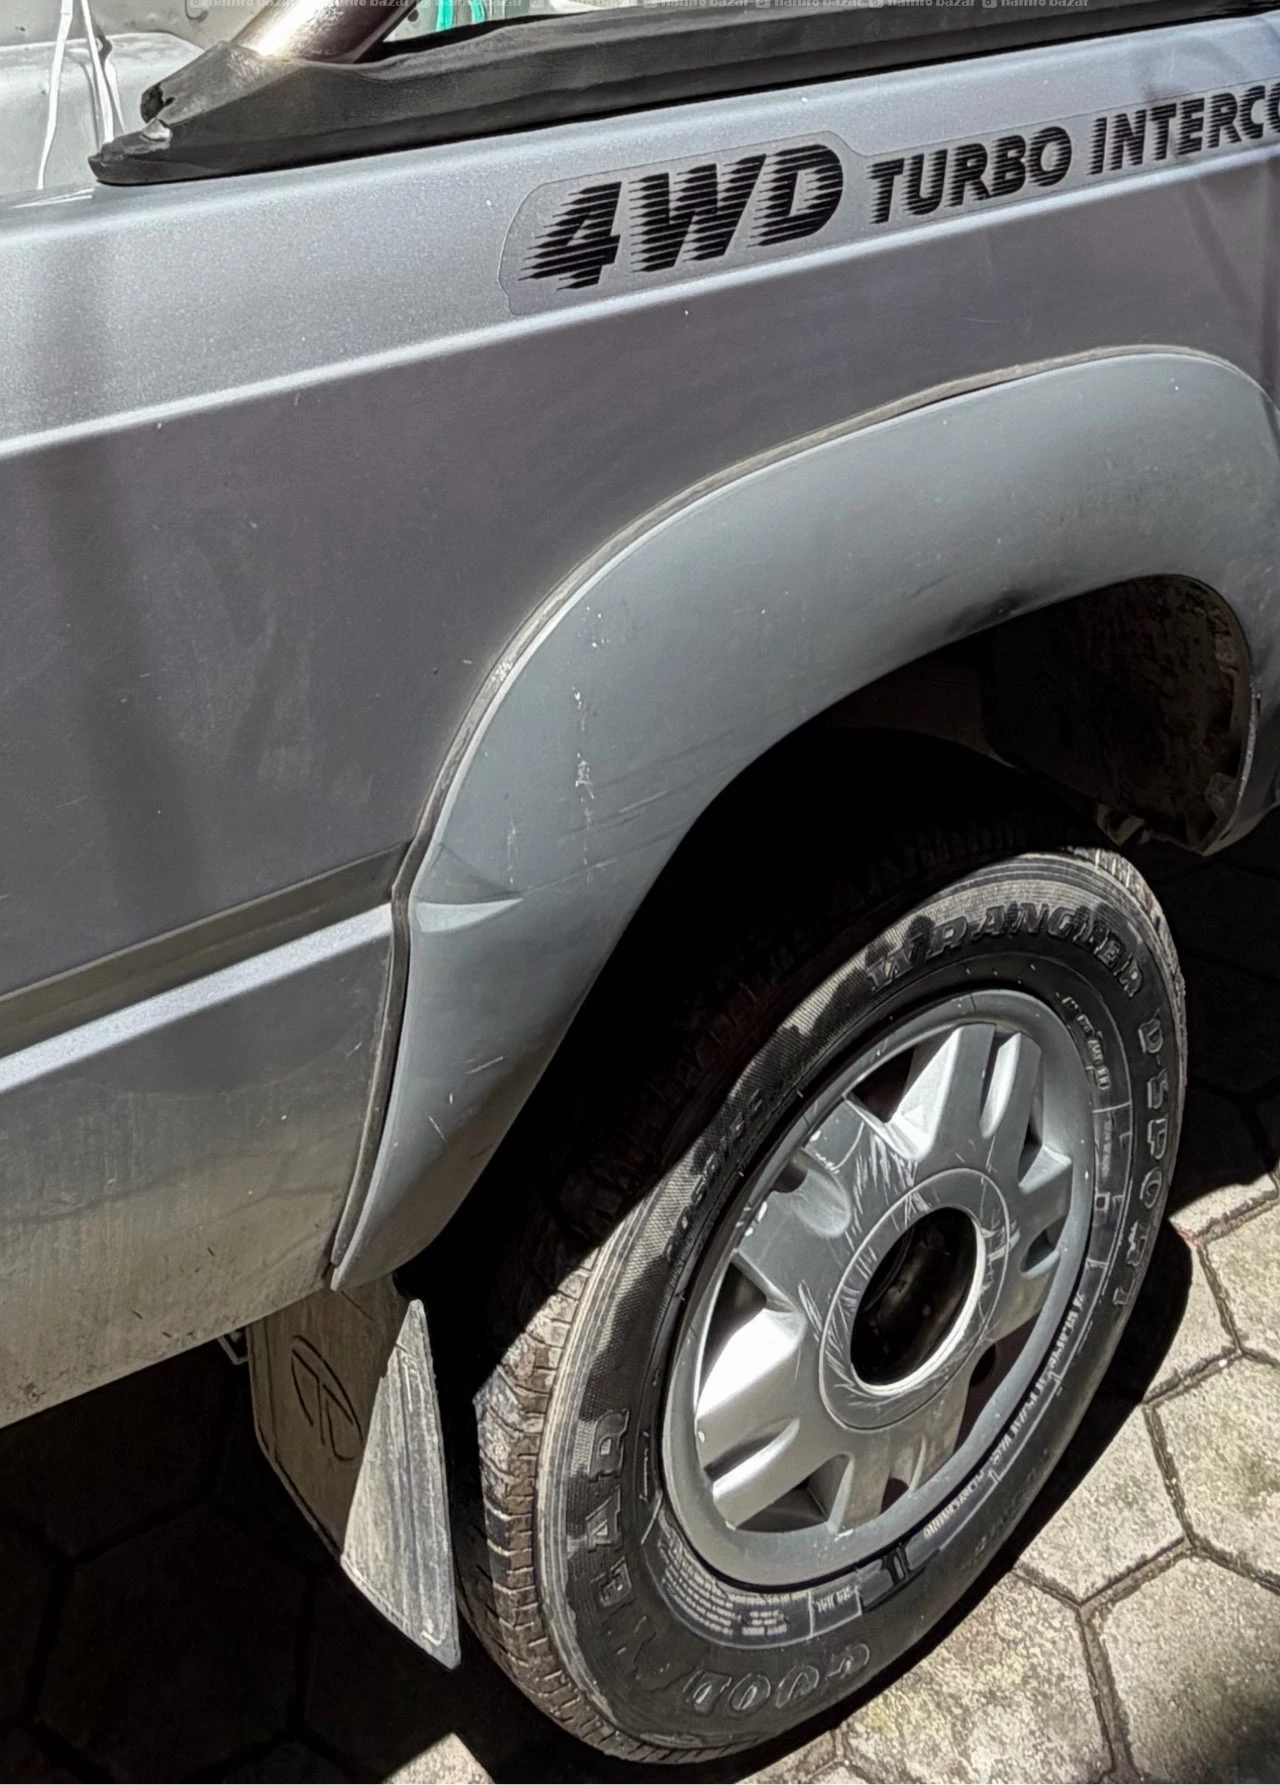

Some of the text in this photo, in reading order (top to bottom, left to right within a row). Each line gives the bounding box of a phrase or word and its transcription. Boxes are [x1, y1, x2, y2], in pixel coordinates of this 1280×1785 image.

[517, 144, 844, 291] 4WD
[865, 127, 1073, 224] TURBO
[866, 901, 1144, 999] WRANGLER
